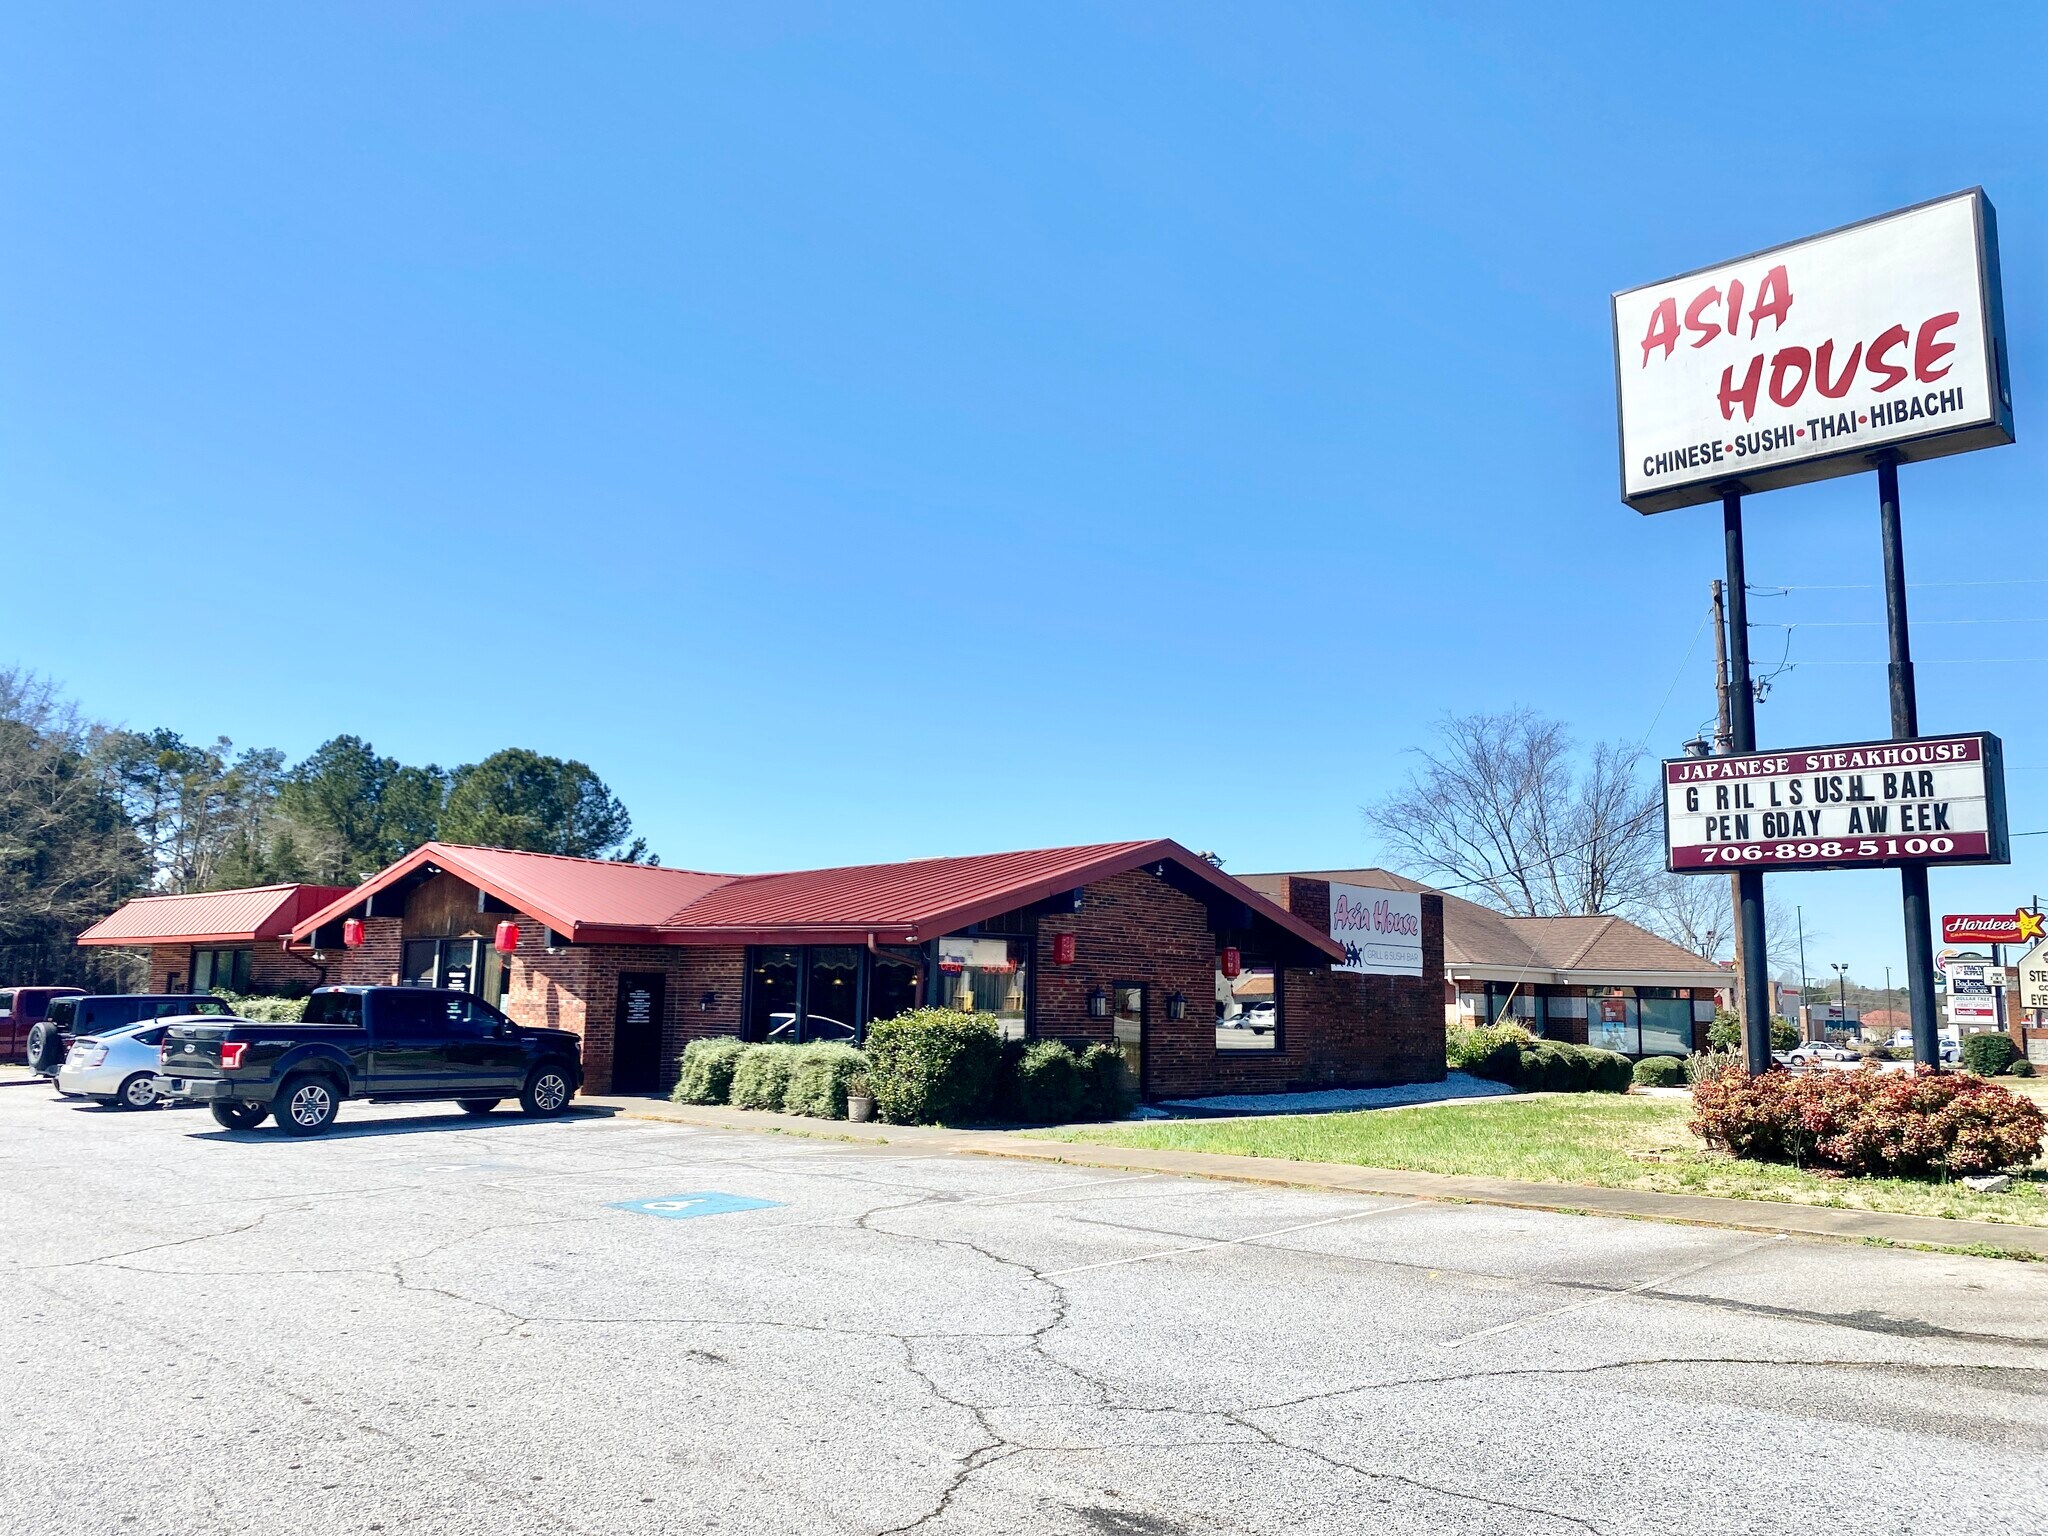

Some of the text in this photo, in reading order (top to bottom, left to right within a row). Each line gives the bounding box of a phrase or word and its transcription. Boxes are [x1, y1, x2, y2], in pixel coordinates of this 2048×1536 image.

[1641, 265, 1793, 369] ASIA
[1716, 311, 1960, 423] HOUSE
[1643, 387, 1964, 477] CHINESE SUSHI THAI HIBACHI
[1679, 743, 1968, 780] JAPANESE STEAKHOUSE
[1883, 770, 1934, 799] BAR
[1705, 814, 1750, 841] PEN
[1700, 838, 1954, 863] 706-898-5100
[1334, 894, 1418, 936] Asia House
[1945, 917, 2017, 932] Hardee's
[940, 963, 961, 972] OPEN
[1367, 950, 1383, 959] GRILL
[1407, 953, 1418, 961] BAR
